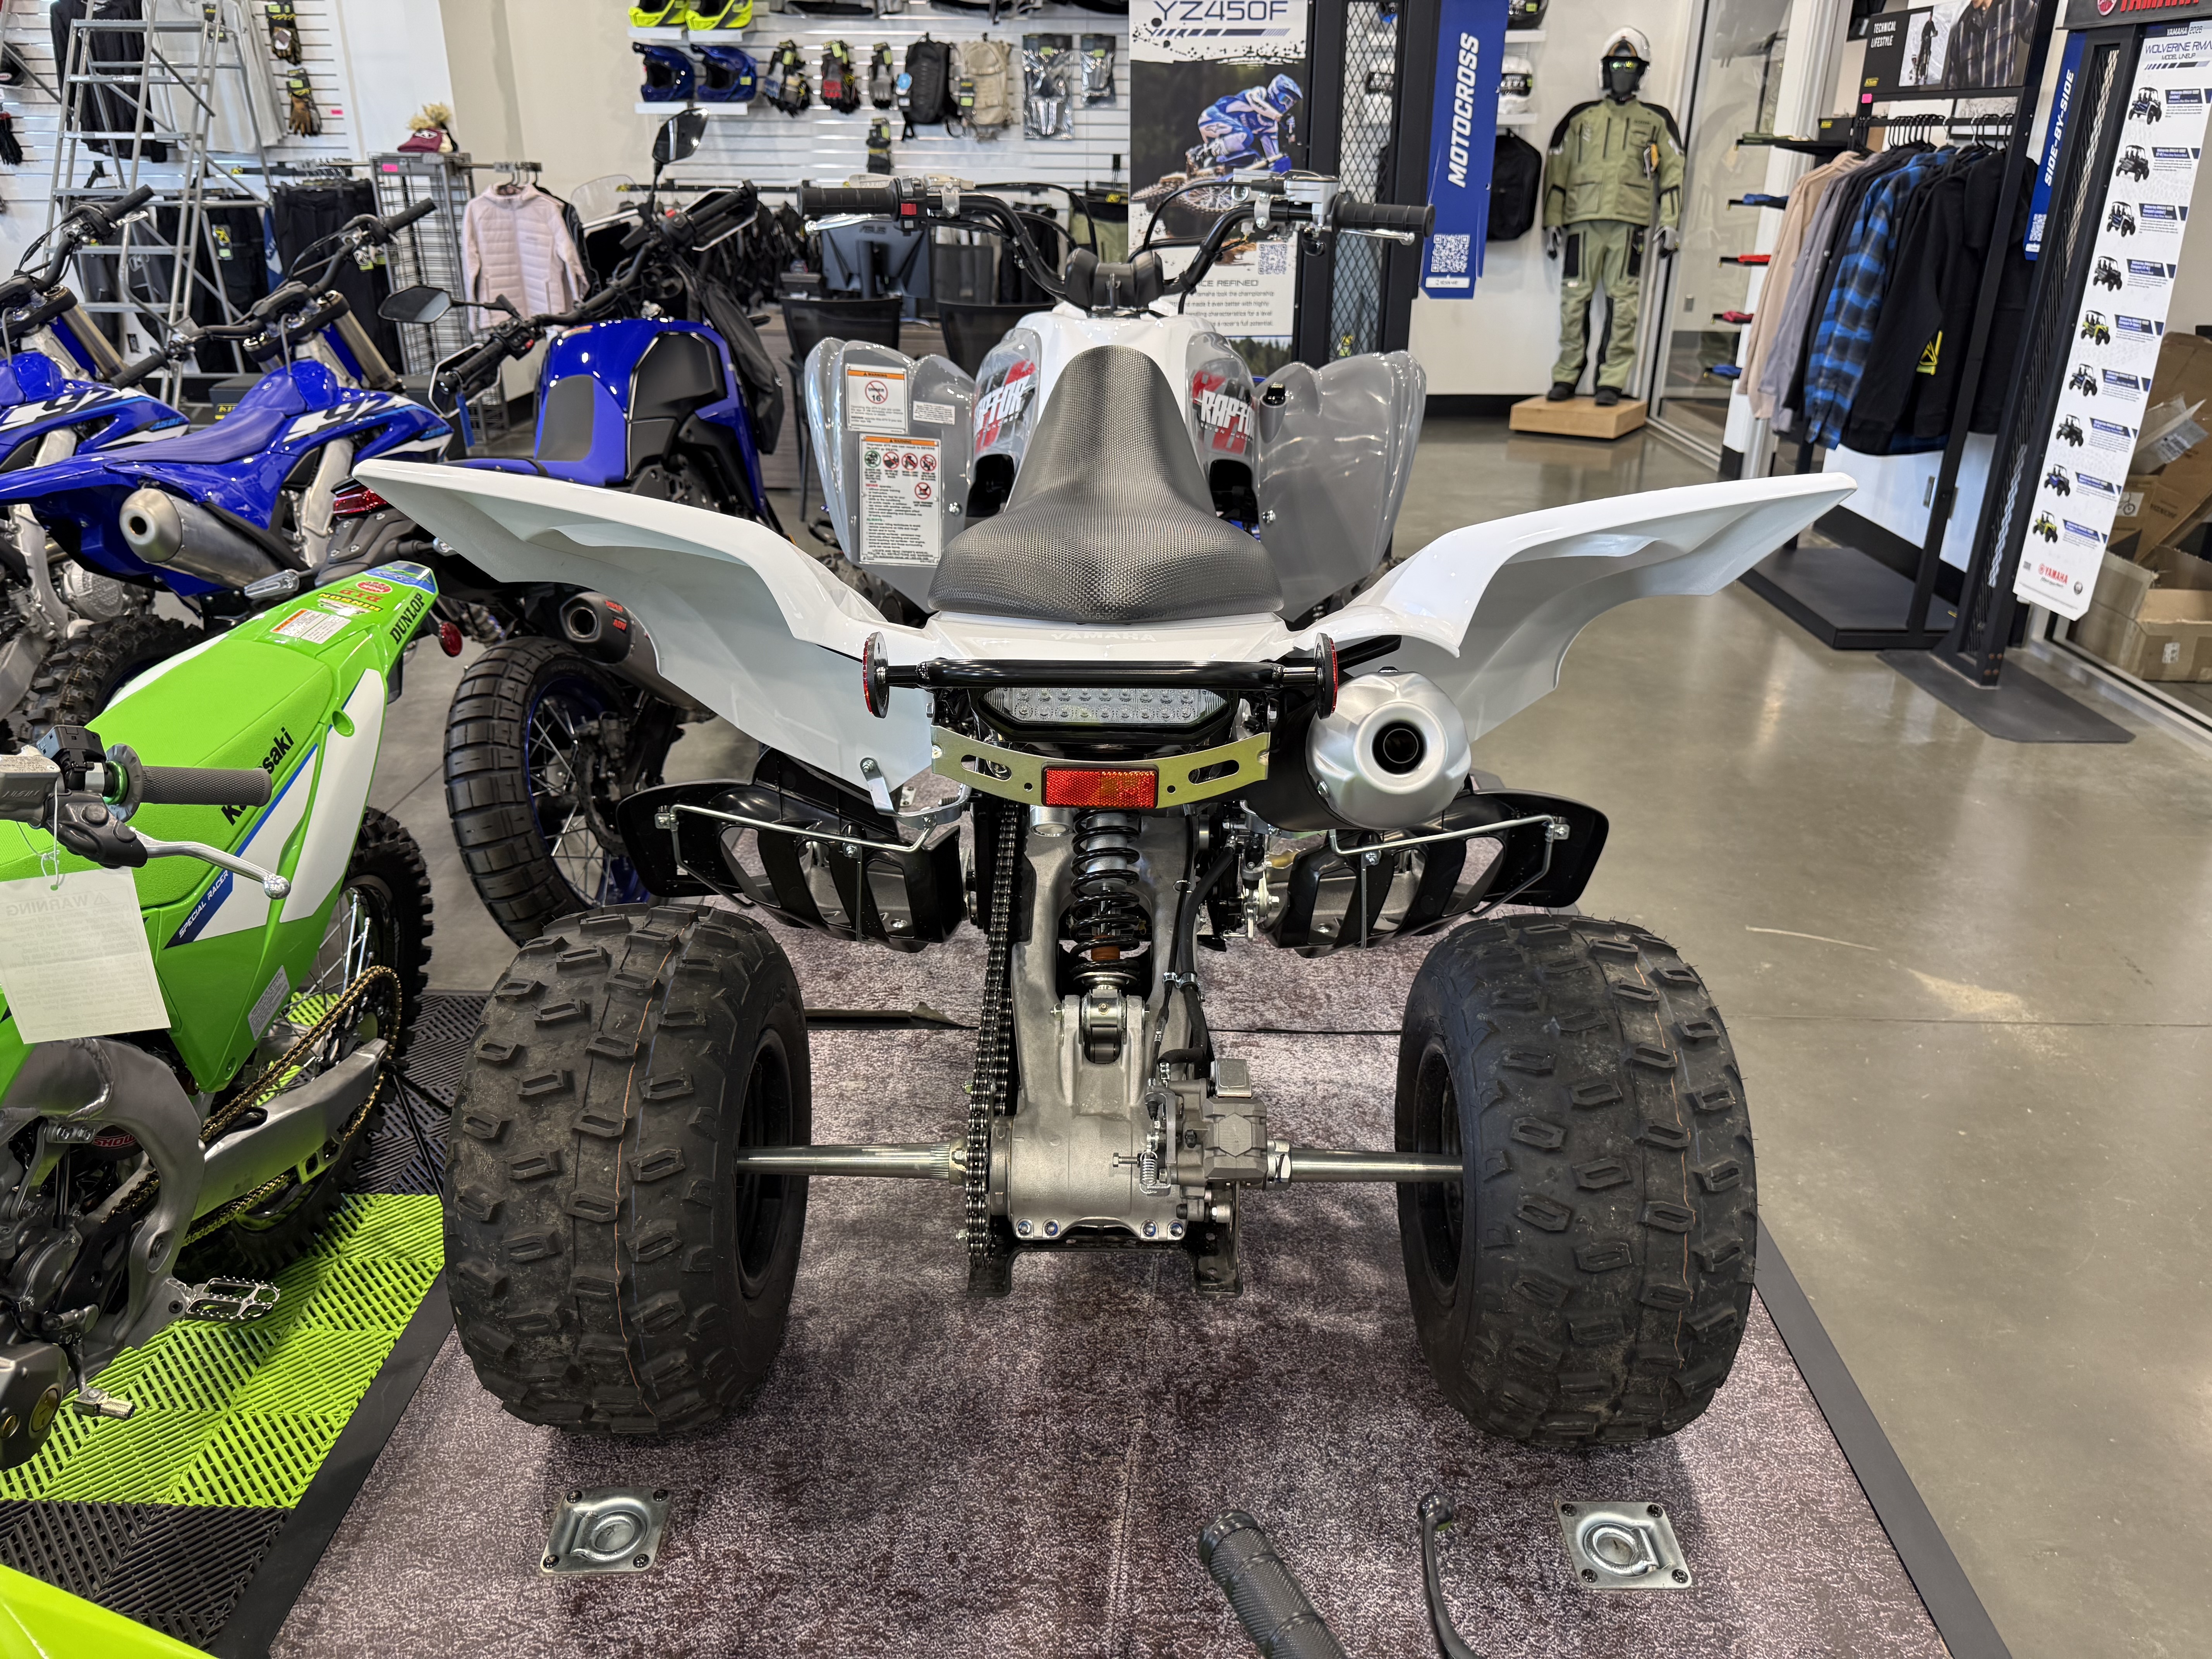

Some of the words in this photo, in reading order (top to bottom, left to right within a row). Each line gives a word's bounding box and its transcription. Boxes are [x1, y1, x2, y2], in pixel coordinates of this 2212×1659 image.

[1154, 1, 1288, 21] YZ450F
[1874, 21, 1896, 34] TECHNICAL
[2167, 27, 2188, 36] YAMAHA
[1871, 35, 1894, 48] LIFESTYLE
[2145, 41, 2191, 53] WOLVERINE
[2192, 40, 2212, 50] RMA
[1448, 32, 1479, 188] MOTOCROSS
[2045, 69, 2074, 186] SIDE-BY-SIDE
[1201, 389, 1254, 438] RAPTO
[2045, 566, 2068, 584] YAMAHA
[389, 592, 425, 644] DUNLOP
[1051, 631, 1157, 642] YAMAHA
[221, 727, 294, 826] Ksaki
[179, 902, 207, 938] SPECIAL
[207, 870, 228, 901] RACER
[92, 1134, 136, 1147] SHOW
